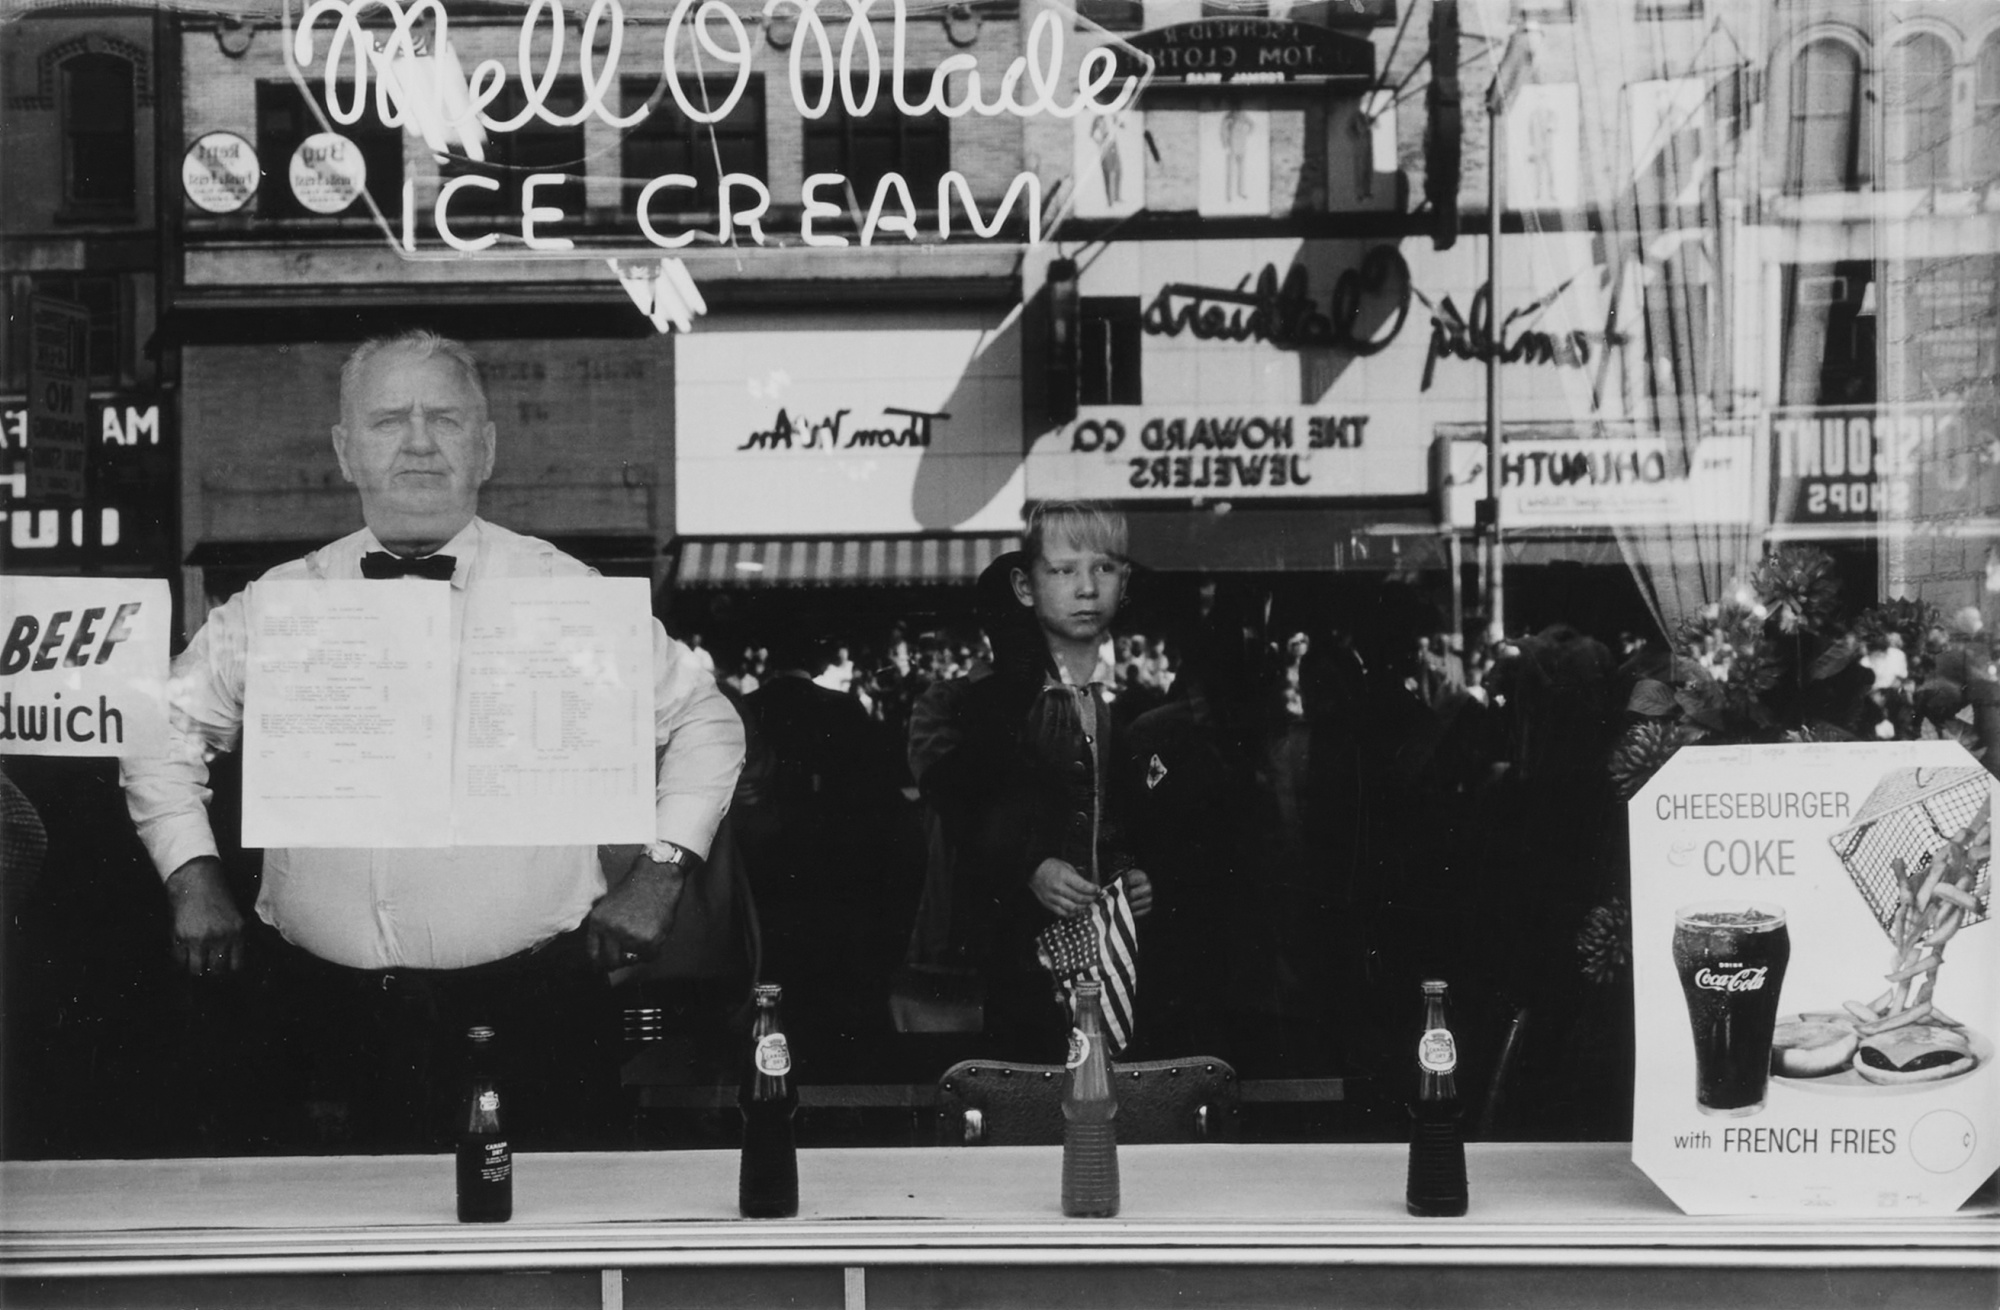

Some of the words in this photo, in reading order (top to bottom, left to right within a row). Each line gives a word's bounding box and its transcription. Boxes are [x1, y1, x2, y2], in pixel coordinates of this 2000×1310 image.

[763, 0, 1138, 119] Made
[403, 174, 574, 251] ICE
[637, 172, 1041, 248] CREAM
[0, 601, 142, 676] BEEF
[1655, 791, 1850, 820] CHEESEBURGER
[1704, 839, 1796, 877] COKE
[1674, 1131, 1711, 1150] with
[1724, 1128, 1818, 1154] FRENCH
[1831, 1128, 1897, 1155] FRIES
